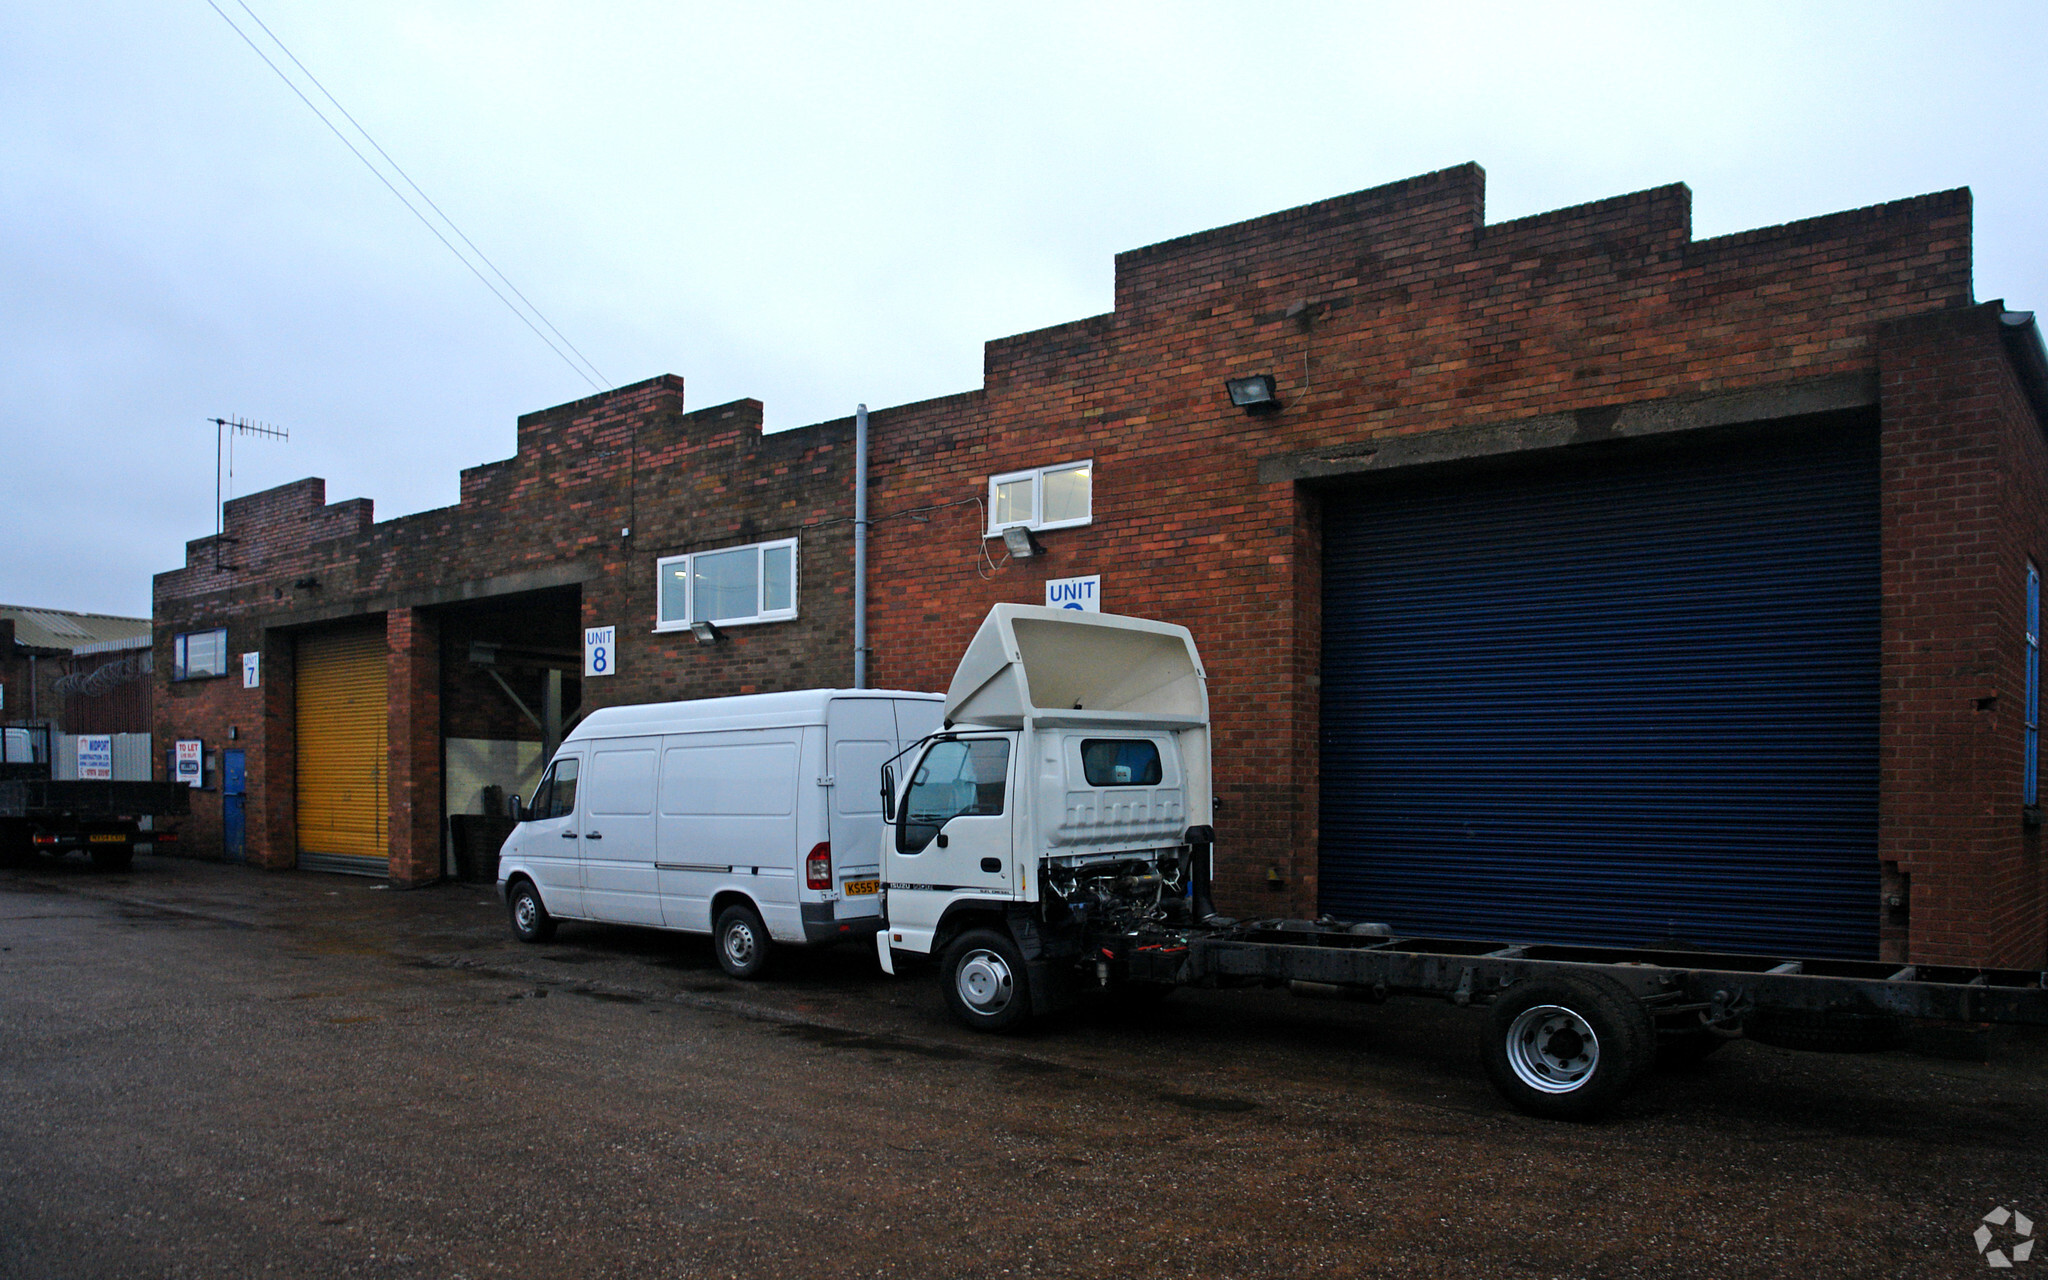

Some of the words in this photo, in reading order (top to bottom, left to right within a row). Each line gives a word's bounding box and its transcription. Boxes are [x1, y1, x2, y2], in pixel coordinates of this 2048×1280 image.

[1050, 581, 1096, 602] UNIT
[587, 631, 612, 645] UNIT
[593, 647, 607, 672] 8
[247, 667, 255, 684] 7
[179, 744, 187, 752] TO
[187, 744, 199, 752] LET
[847, 882, 873, 894] KS55
